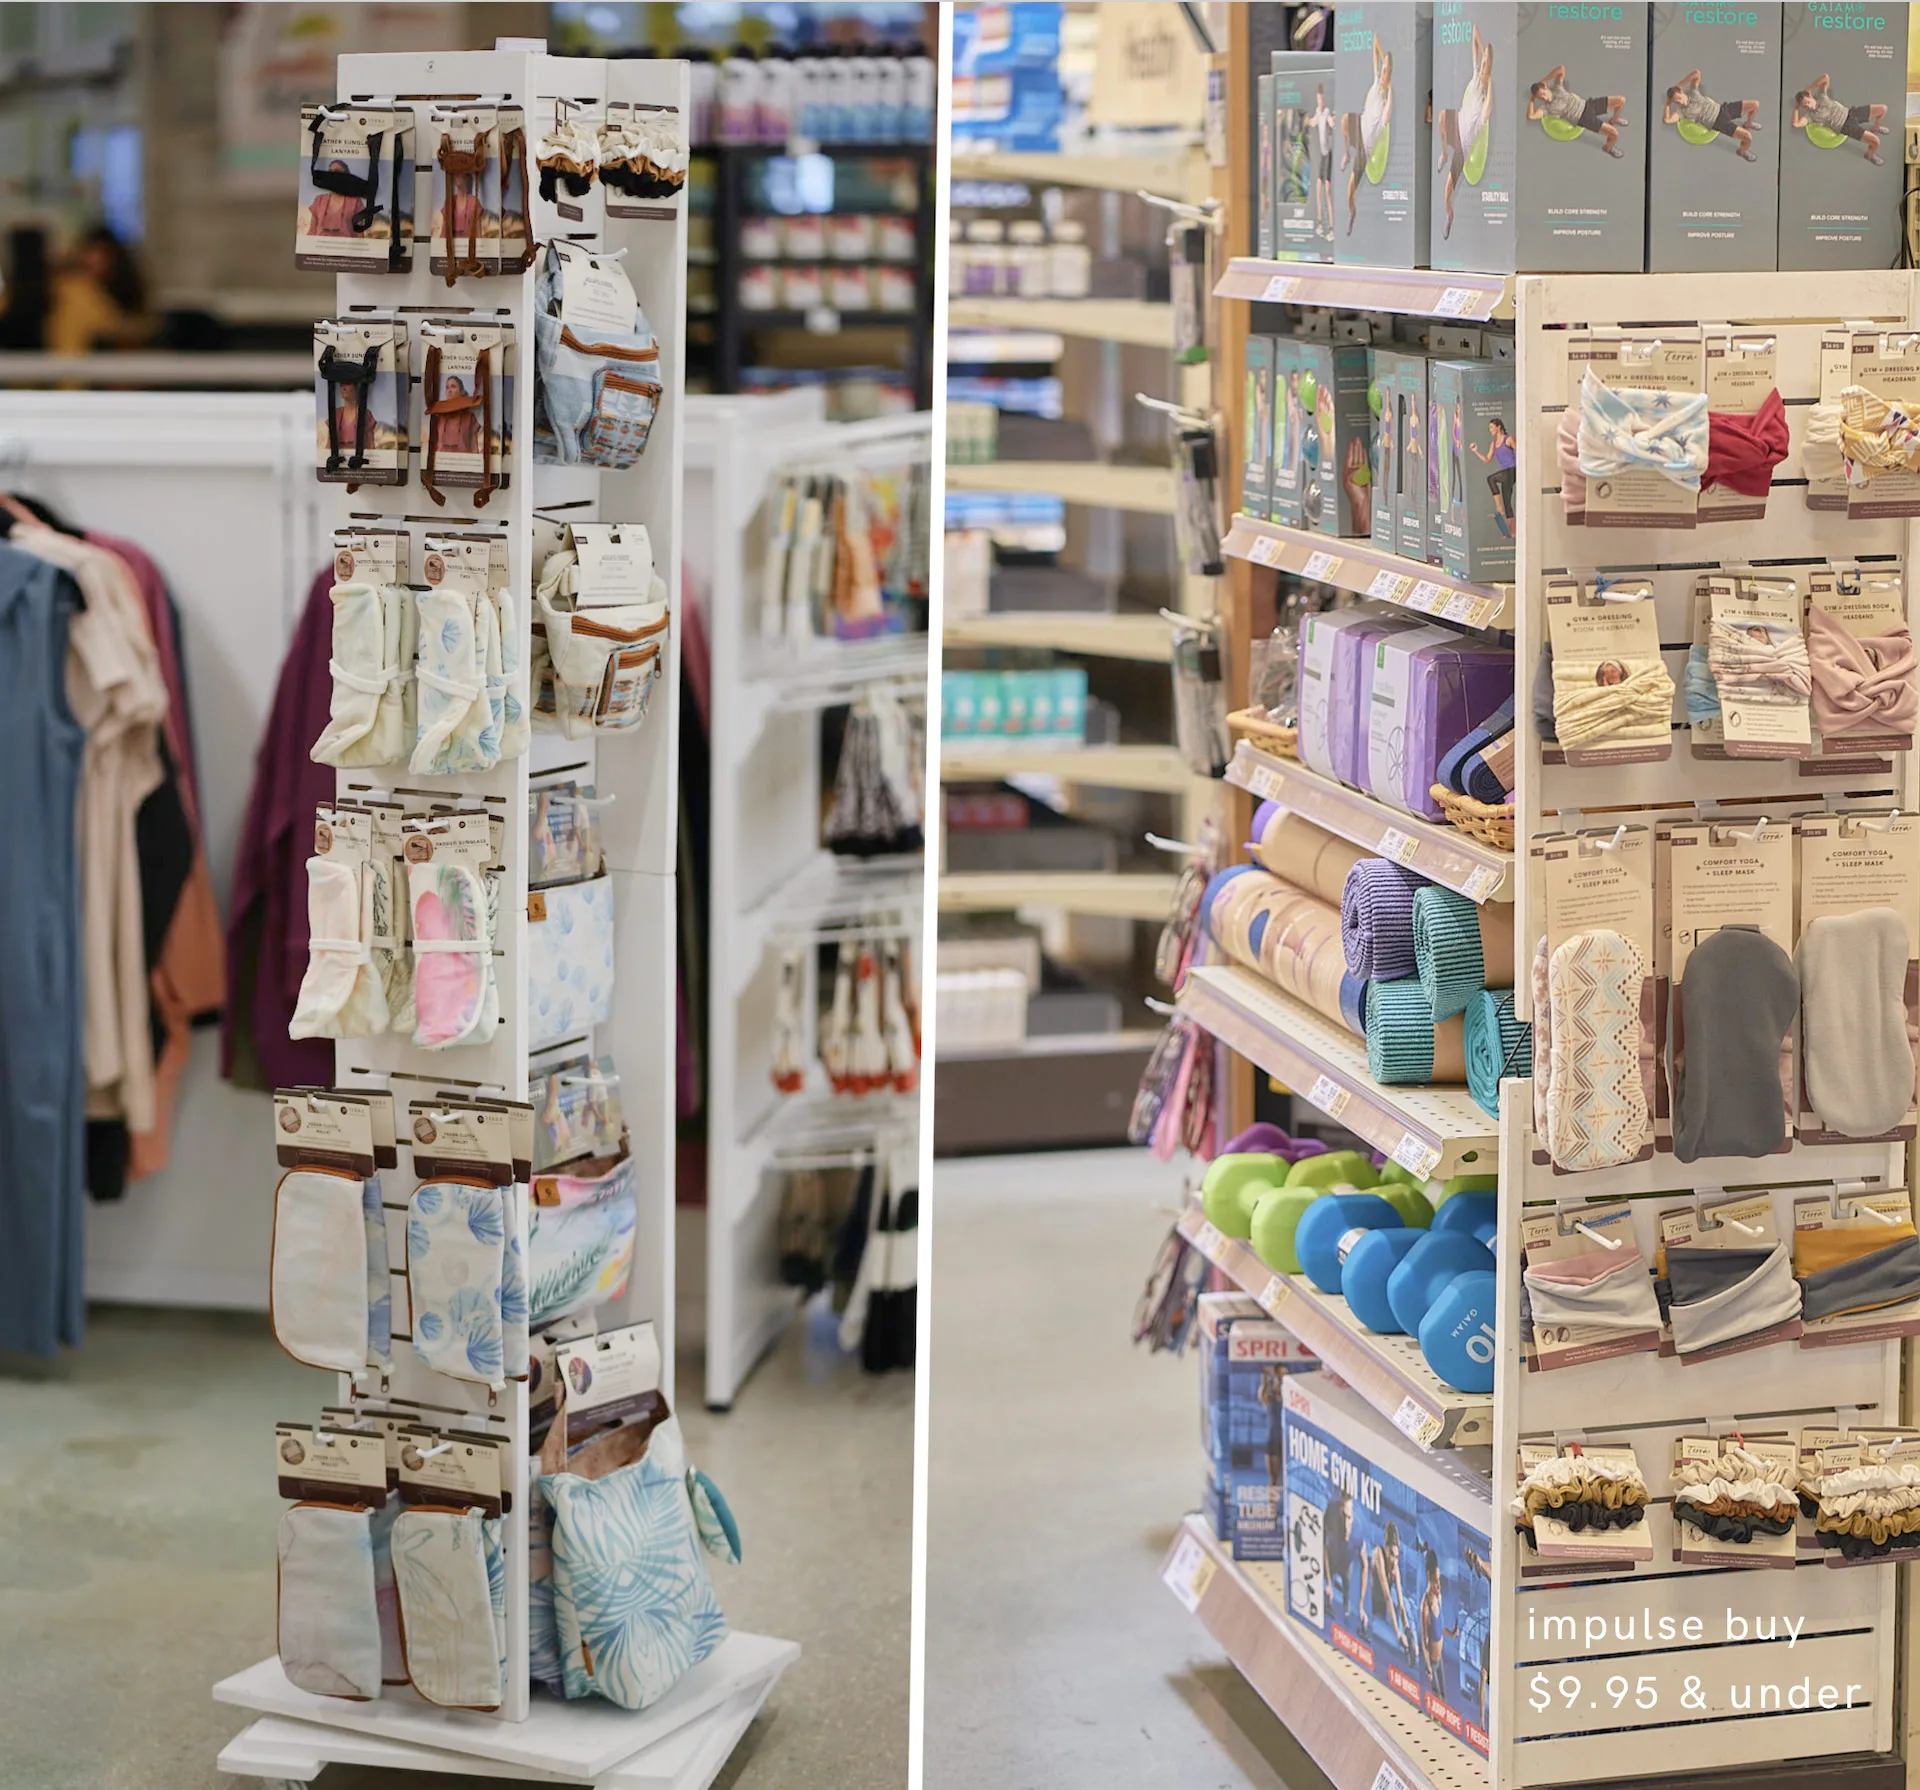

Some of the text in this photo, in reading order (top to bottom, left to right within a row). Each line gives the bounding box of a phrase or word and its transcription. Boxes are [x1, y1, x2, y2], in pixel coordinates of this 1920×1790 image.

[1549, 2, 1623, 20] restore
[1685, 8, 1758, 25] restore
[1814, 13, 1886, 30] restore
[1439, 17, 1472, 45] restore
[1663, 350, 1694, 362] Terra
[1573, 615, 1588, 623] GYM
[1597, 613, 1633, 621] DRESSING
[1596, 623, 1635, 632] HEADBAND
[1573, 869, 1603, 879] COMFORT
[1582, 880, 1600, 888] SLEEP
[1602, 878, 1620, 886] MASK
[1800, 1210, 1823, 1220] Terra
[1528, 1226, 1550, 1237] Terra
[1668, 1223, 1690, 1234] Terra
[1450, 1308, 1478, 1338] GAIAM
[1236, 1339, 1287, 1358] SPRI
[1831, 1455, 1853, 1464] Terra
[1289, 1425, 1383, 1515] HOME GYM KIT
